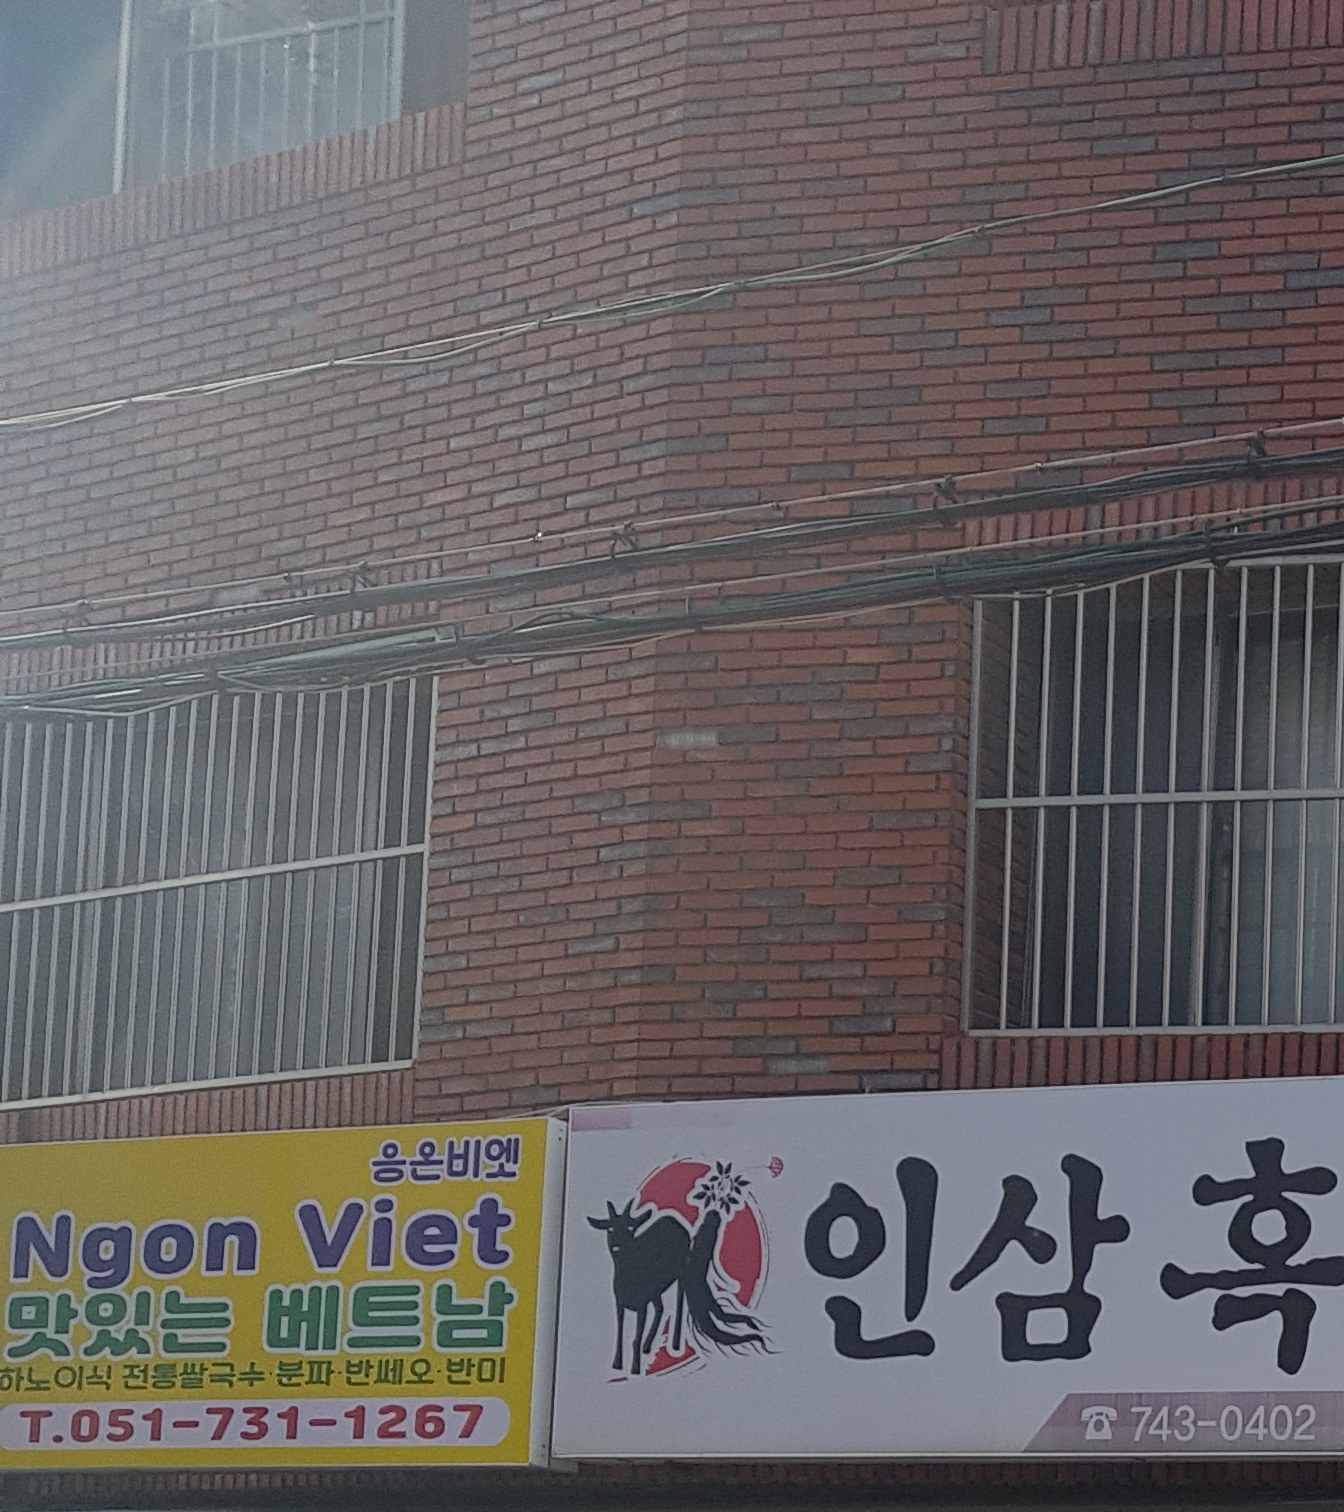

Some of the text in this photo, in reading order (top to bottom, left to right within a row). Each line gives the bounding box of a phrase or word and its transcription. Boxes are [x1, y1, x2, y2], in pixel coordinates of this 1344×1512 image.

[371, 1137, 520, 1183] 응온비엣
[13, 1198, 511, 1290] Ngon Viet
[803, 1153, 1130, 1364] 인삼
[7, 1281, 514, 1358] 맛있는 베트남
[0, 1364, 112, 1391] 하노이식
[19, 1403, 484, 1444] T.051-731-1267
[1130, 1403, 1317, 1443] 743-0402
